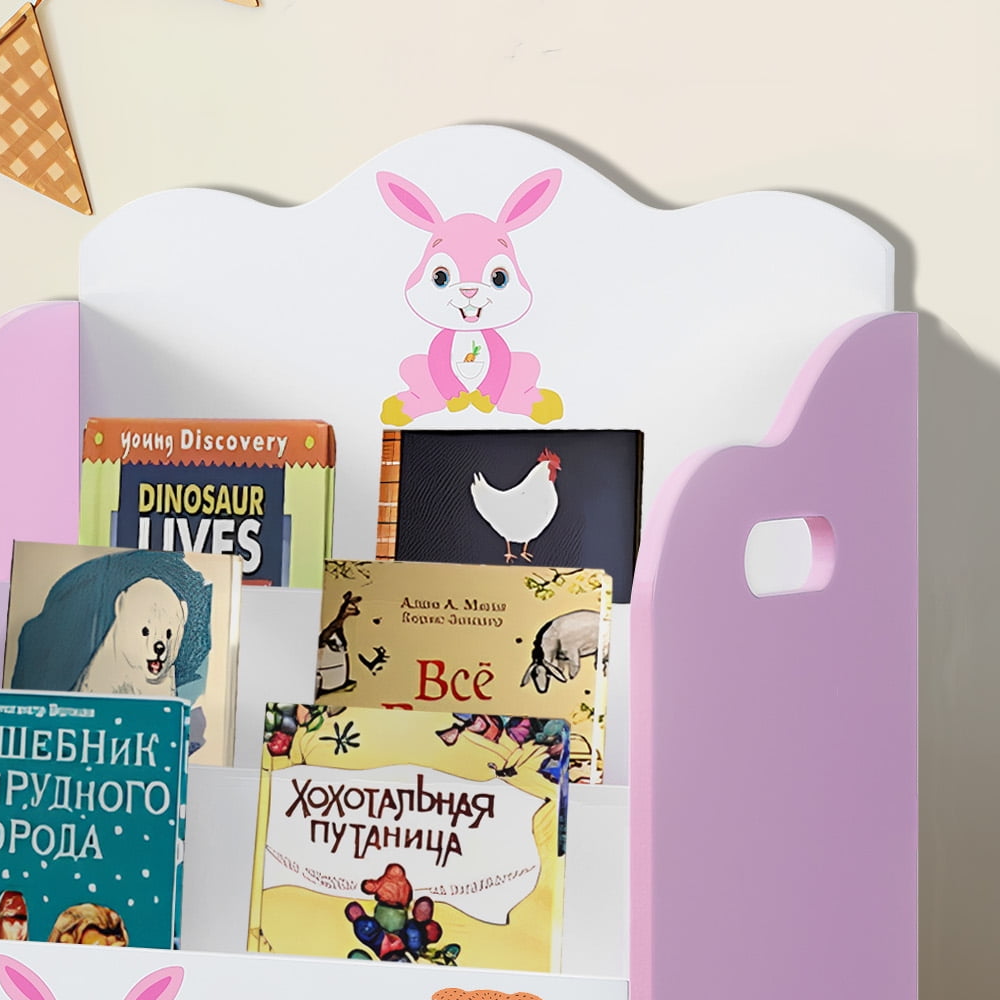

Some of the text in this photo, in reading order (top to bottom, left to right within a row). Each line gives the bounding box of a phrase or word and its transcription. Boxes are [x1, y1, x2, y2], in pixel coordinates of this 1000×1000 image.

[120, 428, 289, 459] young Discovery
[137, 482, 265, 516] DINOSAUR
[414, 659, 495, 702] Всё
[285, 773, 496, 829] ХОХОТАЛЬНАЯ
[310, 819, 463, 868] ПУТАНИЦА
